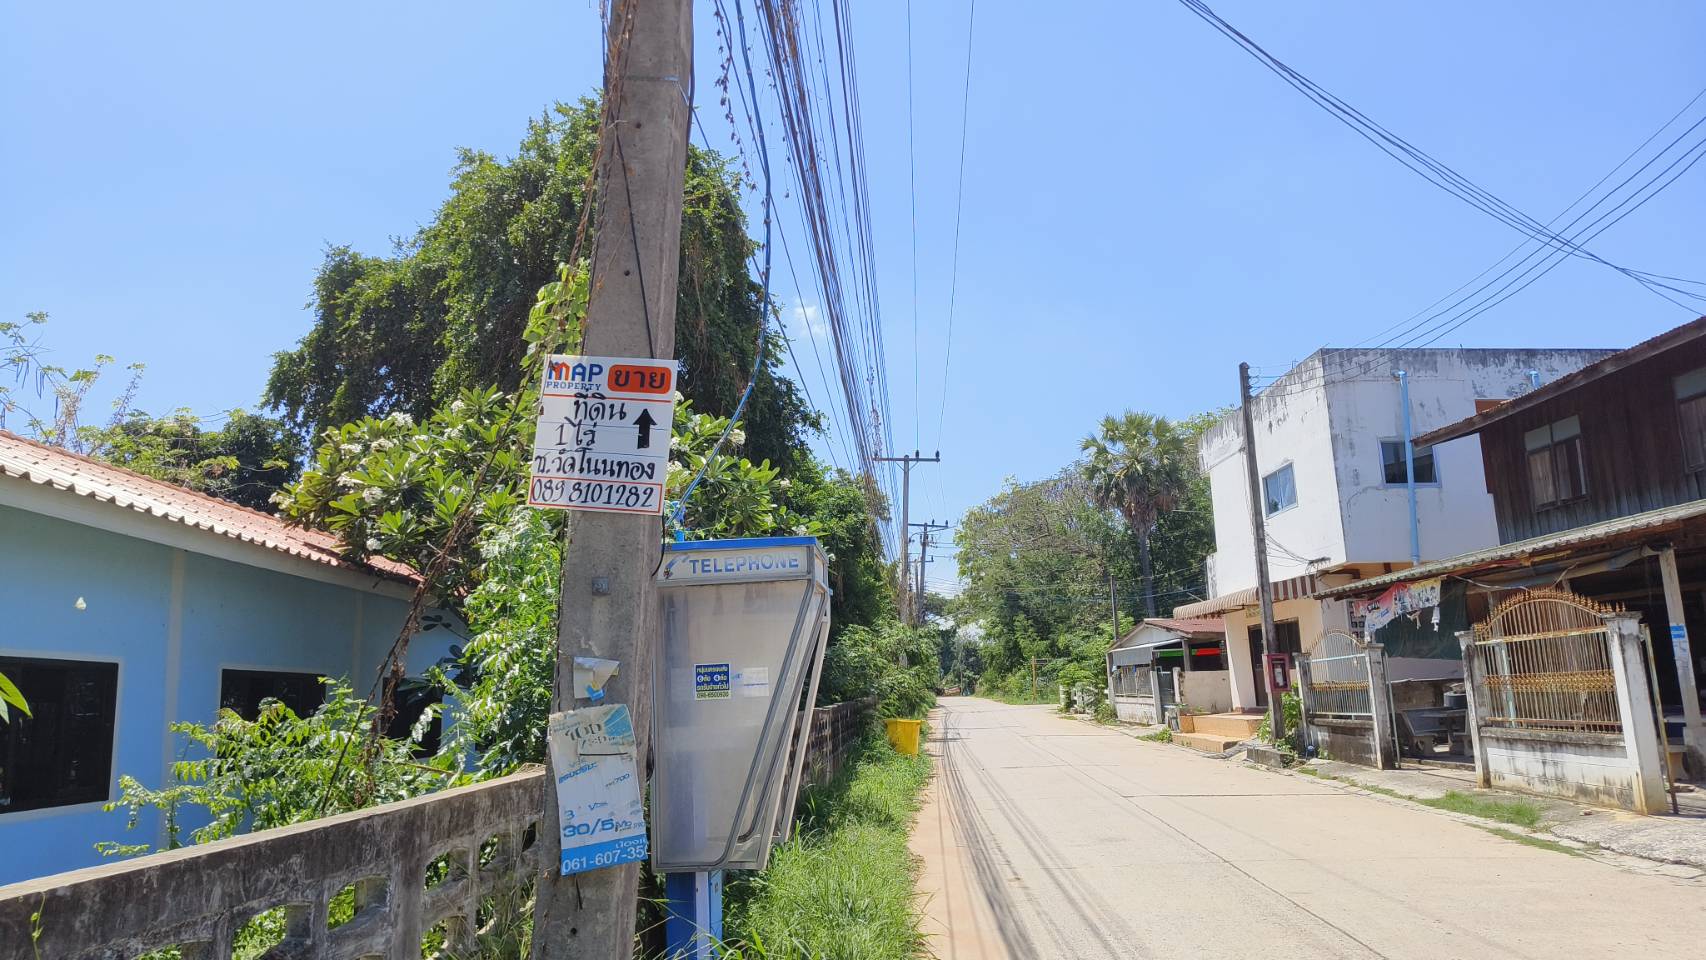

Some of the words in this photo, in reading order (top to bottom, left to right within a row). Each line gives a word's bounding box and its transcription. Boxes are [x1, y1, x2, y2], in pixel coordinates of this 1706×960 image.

[546, 381, 602, 391] PROPERTY
[614, 369, 666, 389] ขาย
[573, 388, 627, 421] ที่ดิน
[554, 424, 568, 446] 1
[564, 416, 597, 447] ไร่
[532, 478, 566, 502] 089
[568, 481, 654, 508] 8101282
[688, 553, 799, 574] TELEPHONE
